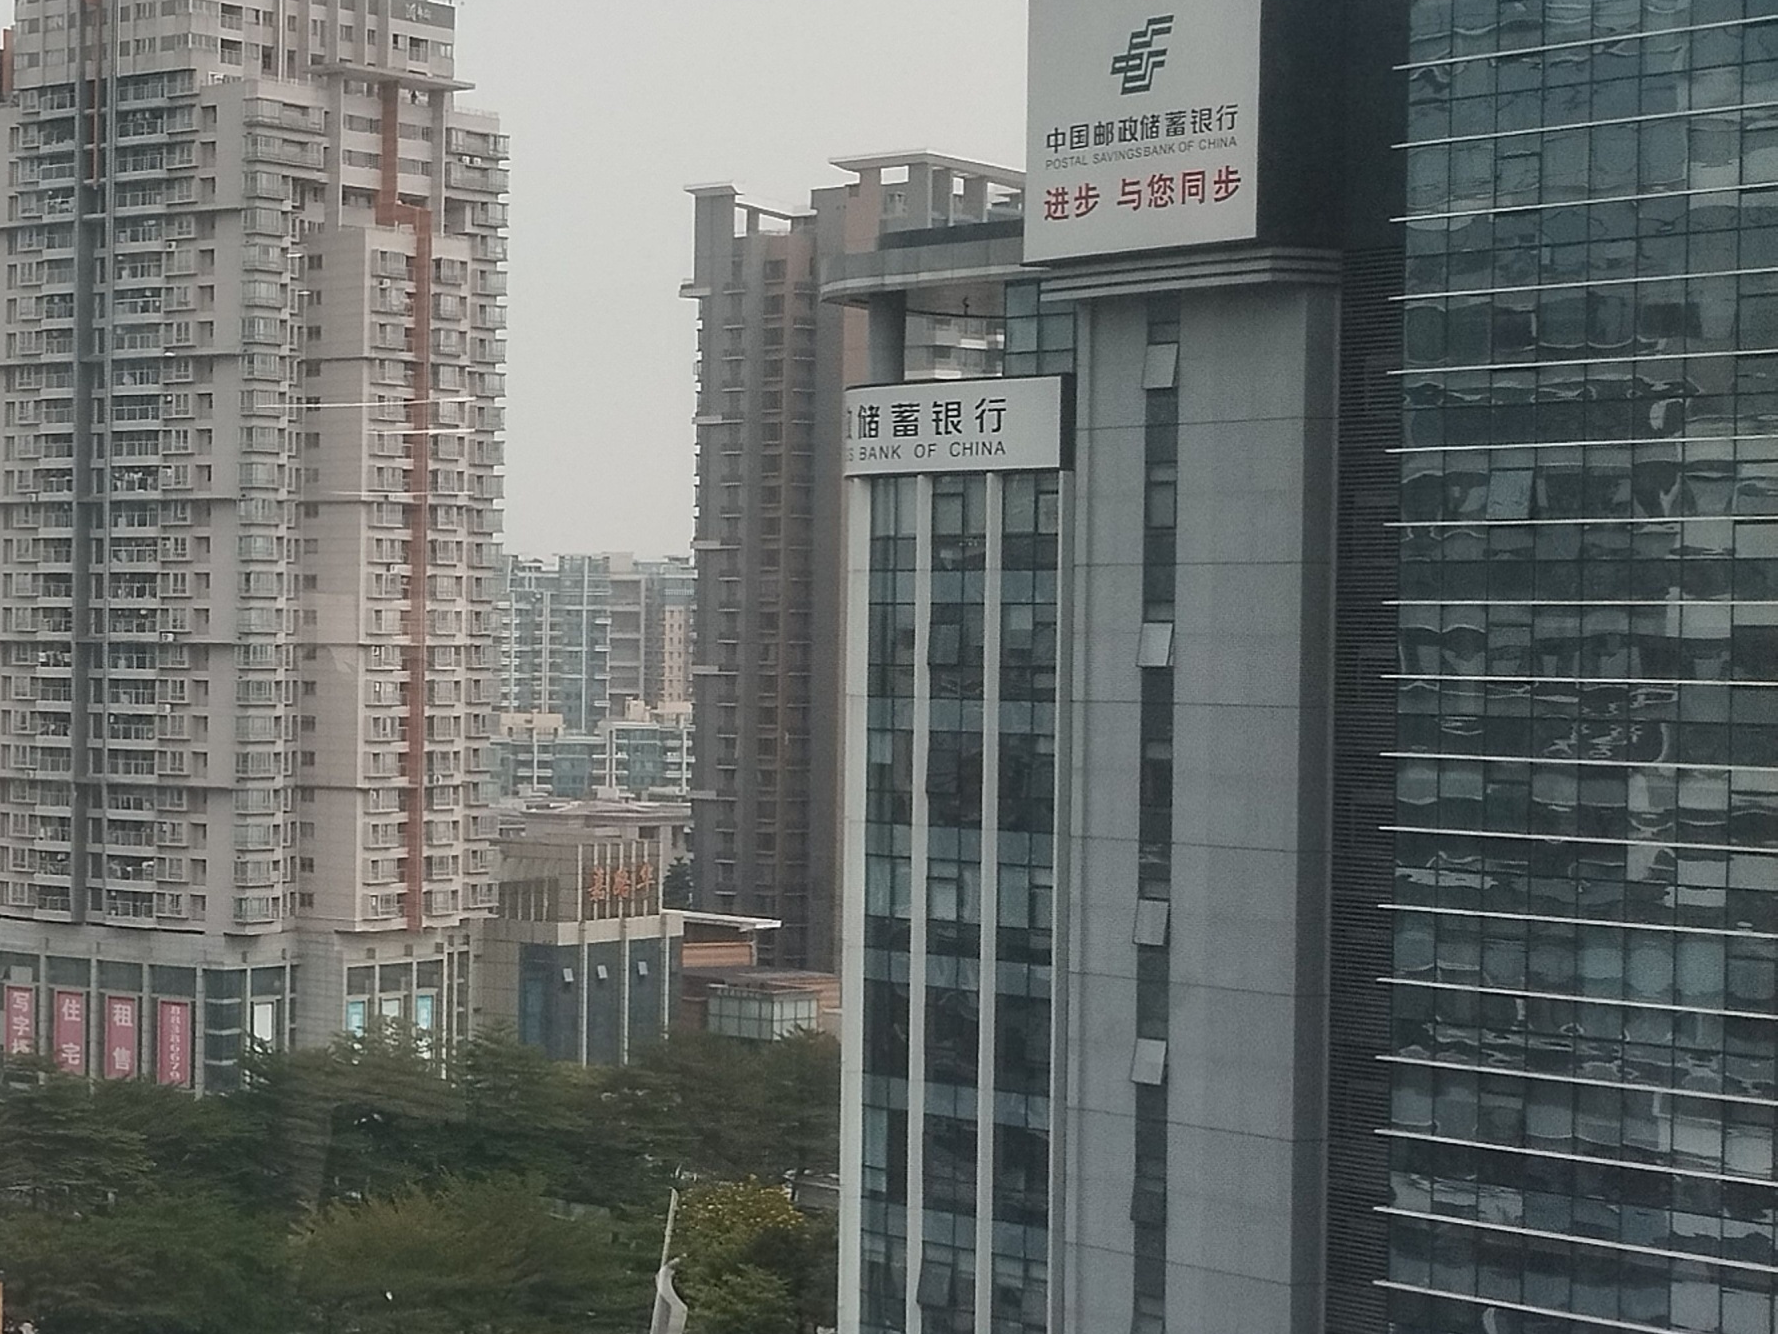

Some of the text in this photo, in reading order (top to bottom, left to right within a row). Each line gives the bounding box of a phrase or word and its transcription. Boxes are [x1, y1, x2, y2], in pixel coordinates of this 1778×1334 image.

[1046, 104, 1238, 154] 中国邮政储蓄银行
[1046, 156, 1088, 170] POSTAL
[1178, 140, 1194, 153] OF
[1198, 136, 1237, 150] CHINA
[1044, 165, 1241, 221] 进步 与您同步
[859, 444, 902, 461] BANK
[914, 443, 937, 458] OF
[949, 440, 1006, 457] CHINA
[61, 998, 81, 1066] 住宅
[112, 1004, 133, 1071] 租售
